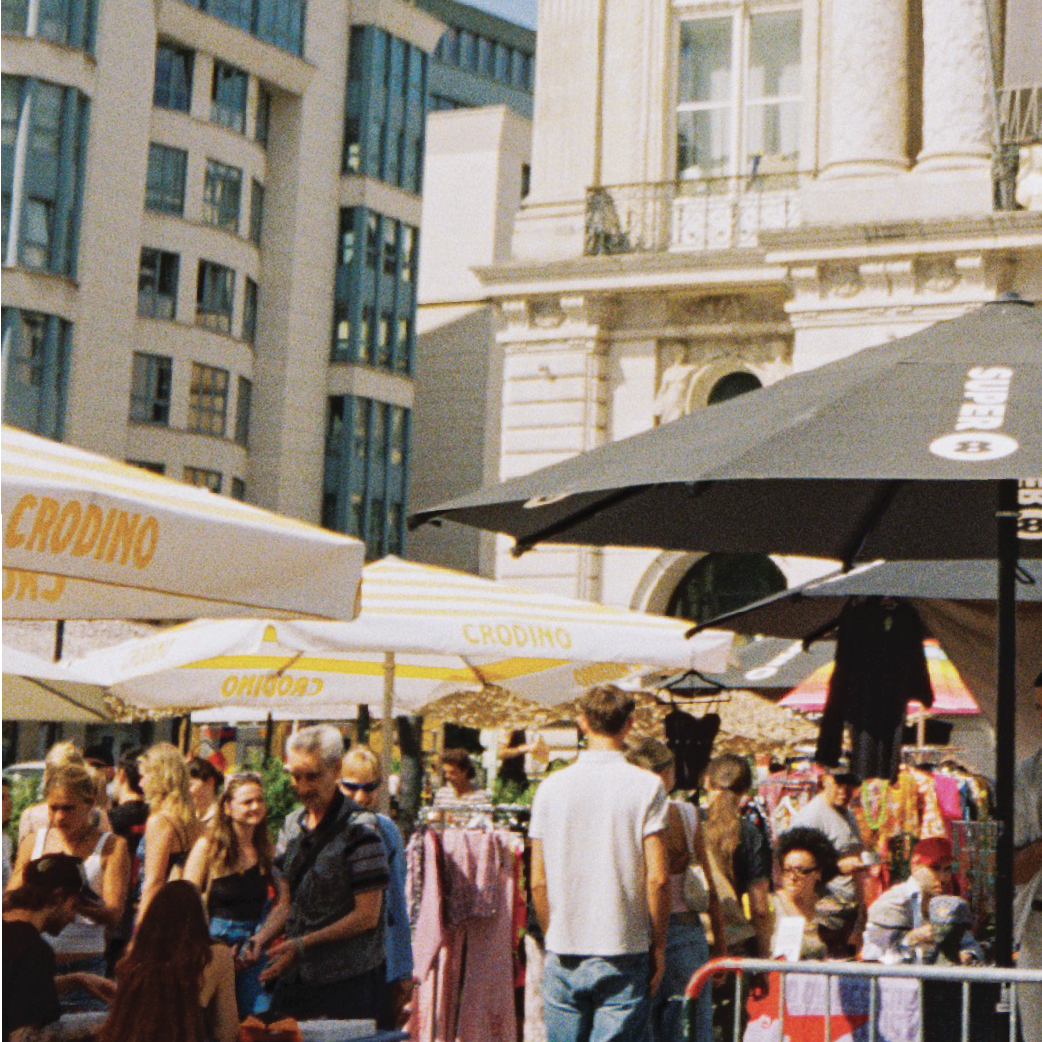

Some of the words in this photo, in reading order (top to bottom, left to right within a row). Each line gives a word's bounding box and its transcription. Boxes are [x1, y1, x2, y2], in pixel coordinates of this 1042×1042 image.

[955, 366, 1013, 431] SUPER
[5, 494, 159, 570] CRODINO
[462, 623, 572, 650] CRODINO
